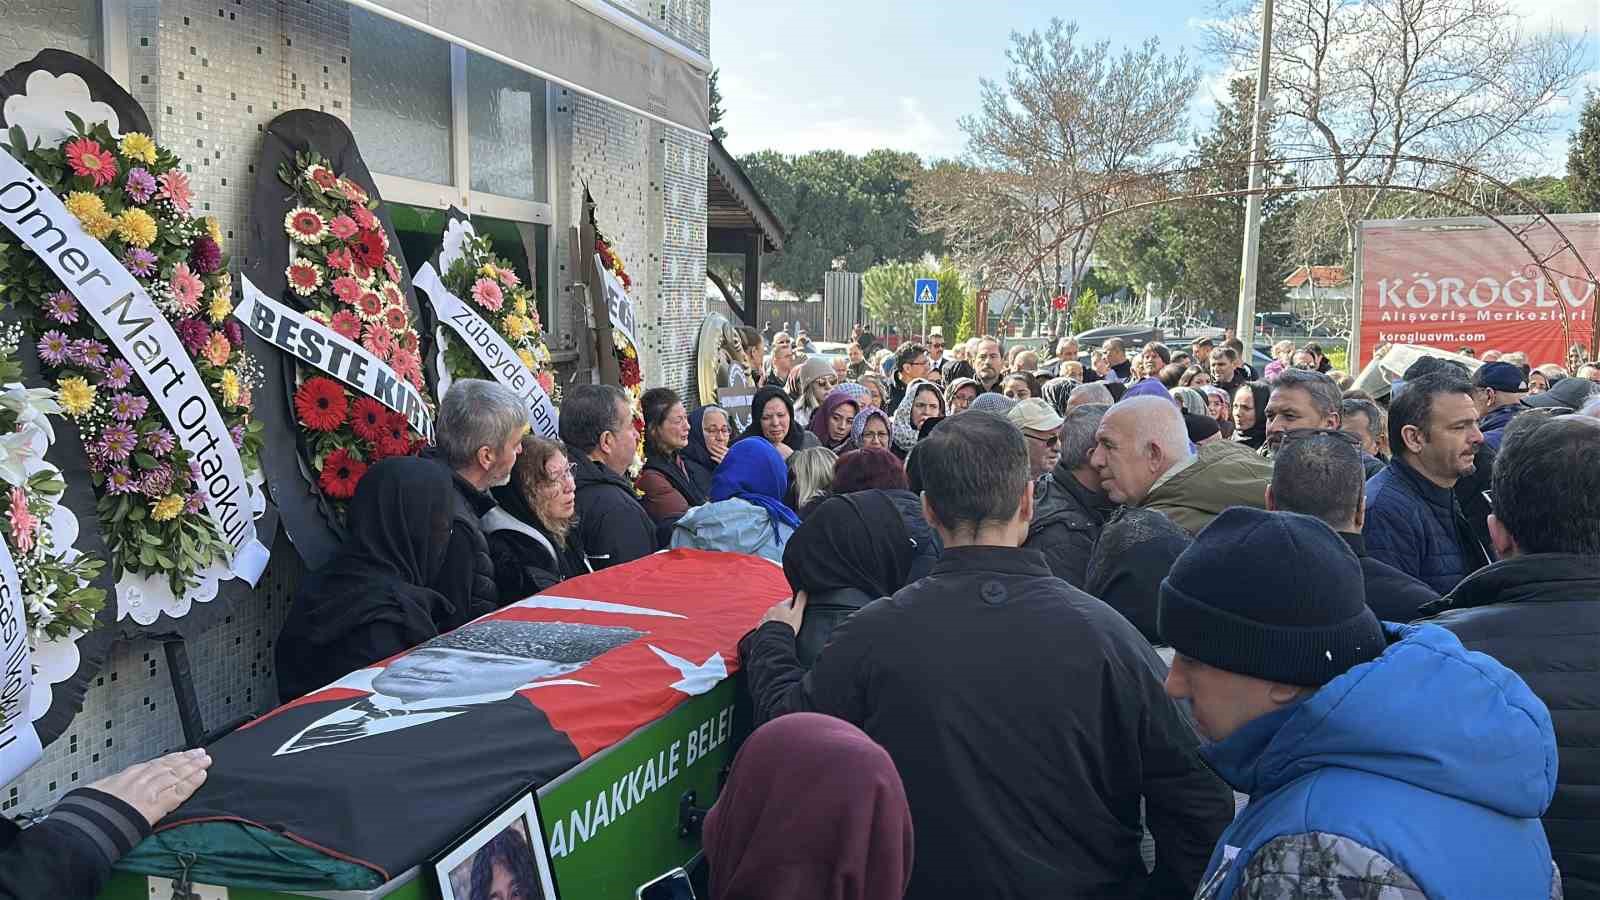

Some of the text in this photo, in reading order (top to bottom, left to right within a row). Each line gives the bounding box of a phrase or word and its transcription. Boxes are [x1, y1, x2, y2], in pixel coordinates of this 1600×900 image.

[0, 176, 111, 290] Ömer
[102, 292, 186, 399] Mart
[1381, 310, 1467, 324] Alışveriş
[250, 298, 371, 389] BESTE
[450, 305, 527, 392] Zübeyde
[1379, 331, 1486, 343] korogluavm.com
[549, 738, 681, 859] ANAKKALE
